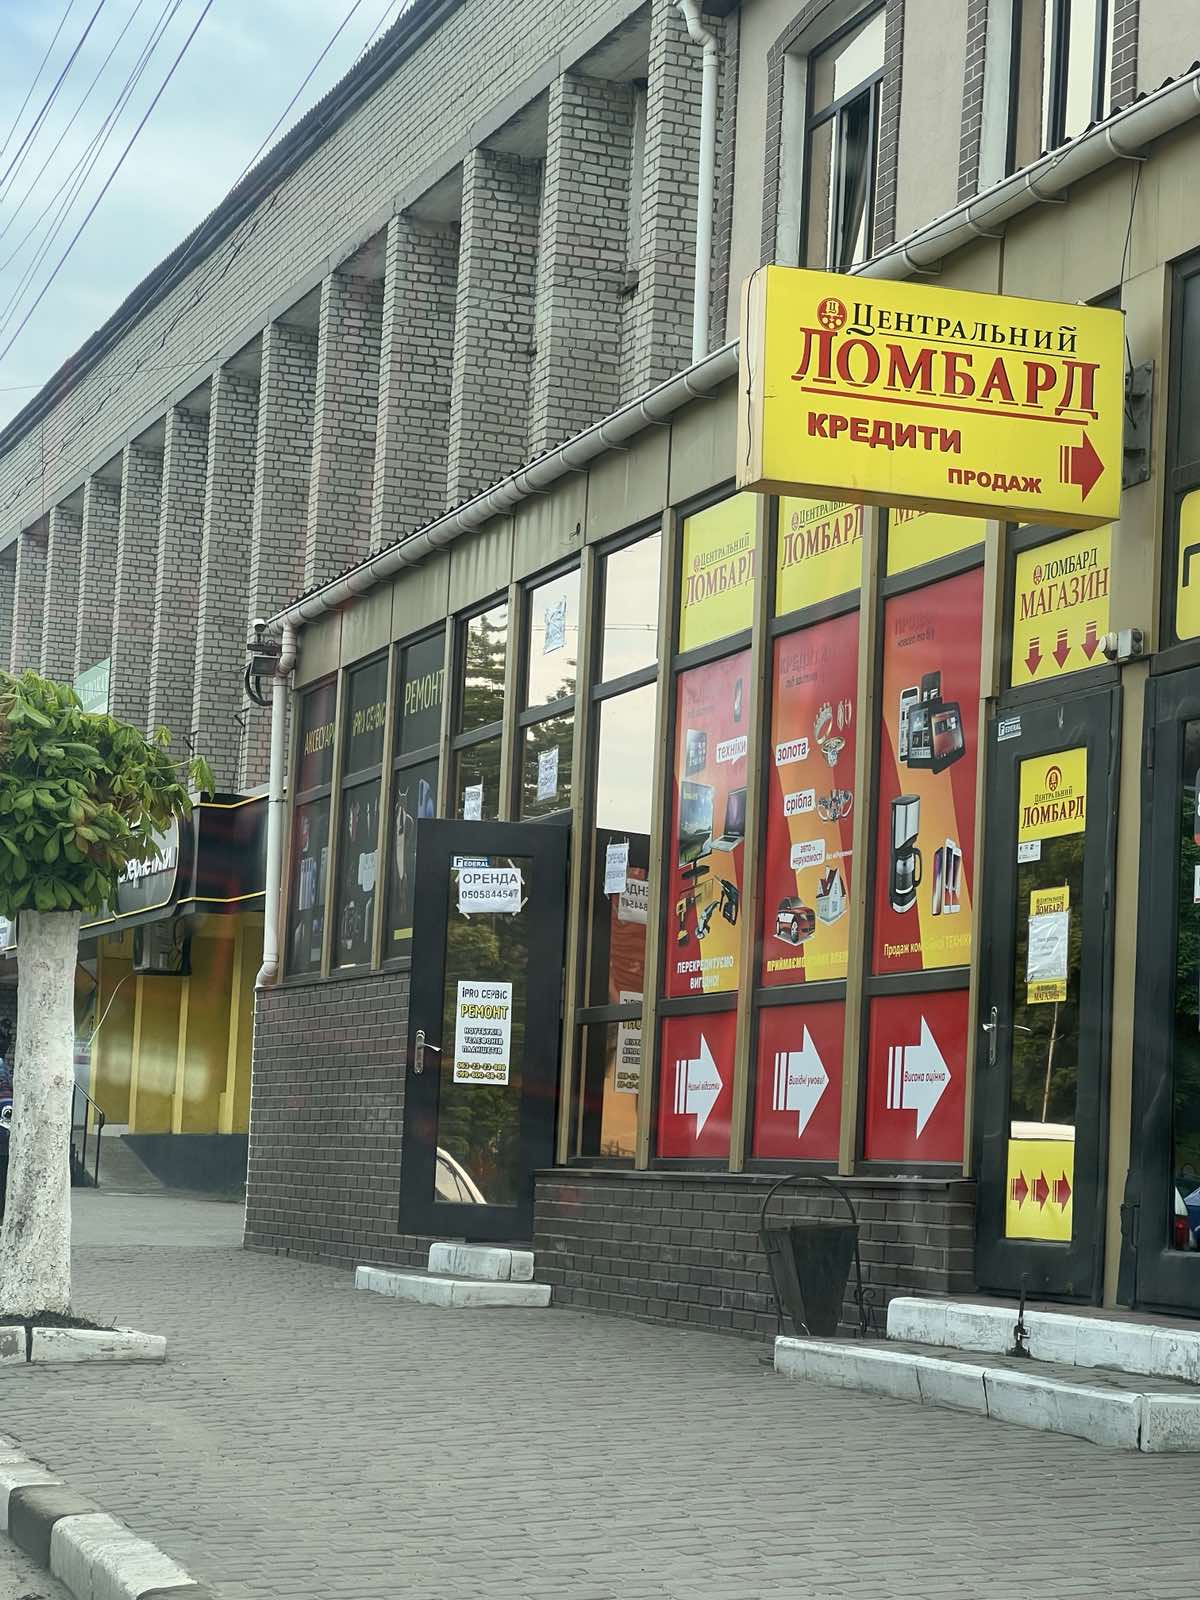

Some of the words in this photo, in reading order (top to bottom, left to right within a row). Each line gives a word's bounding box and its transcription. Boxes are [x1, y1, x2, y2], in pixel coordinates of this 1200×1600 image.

[845, 302, 1077, 353] ЦЕНТРАЛЬНИЙ
[791, 327, 1100, 420] ЛОМБАРД
[807, 411, 961, 454] КРЕДИТИ
[947, 468, 1042, 494] ПРОДАЖ
[781, 505, 864, 570] ЛОМБАРД
[701, 532, 750, 570] ЦЕНТРАЛЬНИЙ
[1042, 547, 1098, 582] ЛОМБАРД
[684, 548, 756, 608] ЛОМБАРД
[1020, 567, 1109, 621] МАГАЗИН
[404, 669, 445, 717] РЕМОНТ
[998, 721, 1022, 736] FEDERAL
[718, 739, 746, 761] техніки
[777, 741, 807, 762] золота
[786, 793, 812, 814] срібла
[1034, 785, 1073, 805] ЦЕНТРАЛЬНИЙ
[1021, 796, 1085, 829] ЛОМБАРД
[453, 856, 489, 867] FEDERAL
[462, 873, 519, 886] ОРЕНДА
[884, 943, 910, 958] Продаж
[460, 1004, 509, 1020] РЕМОНТ
[904, 1070, 924, 1082] Висока
